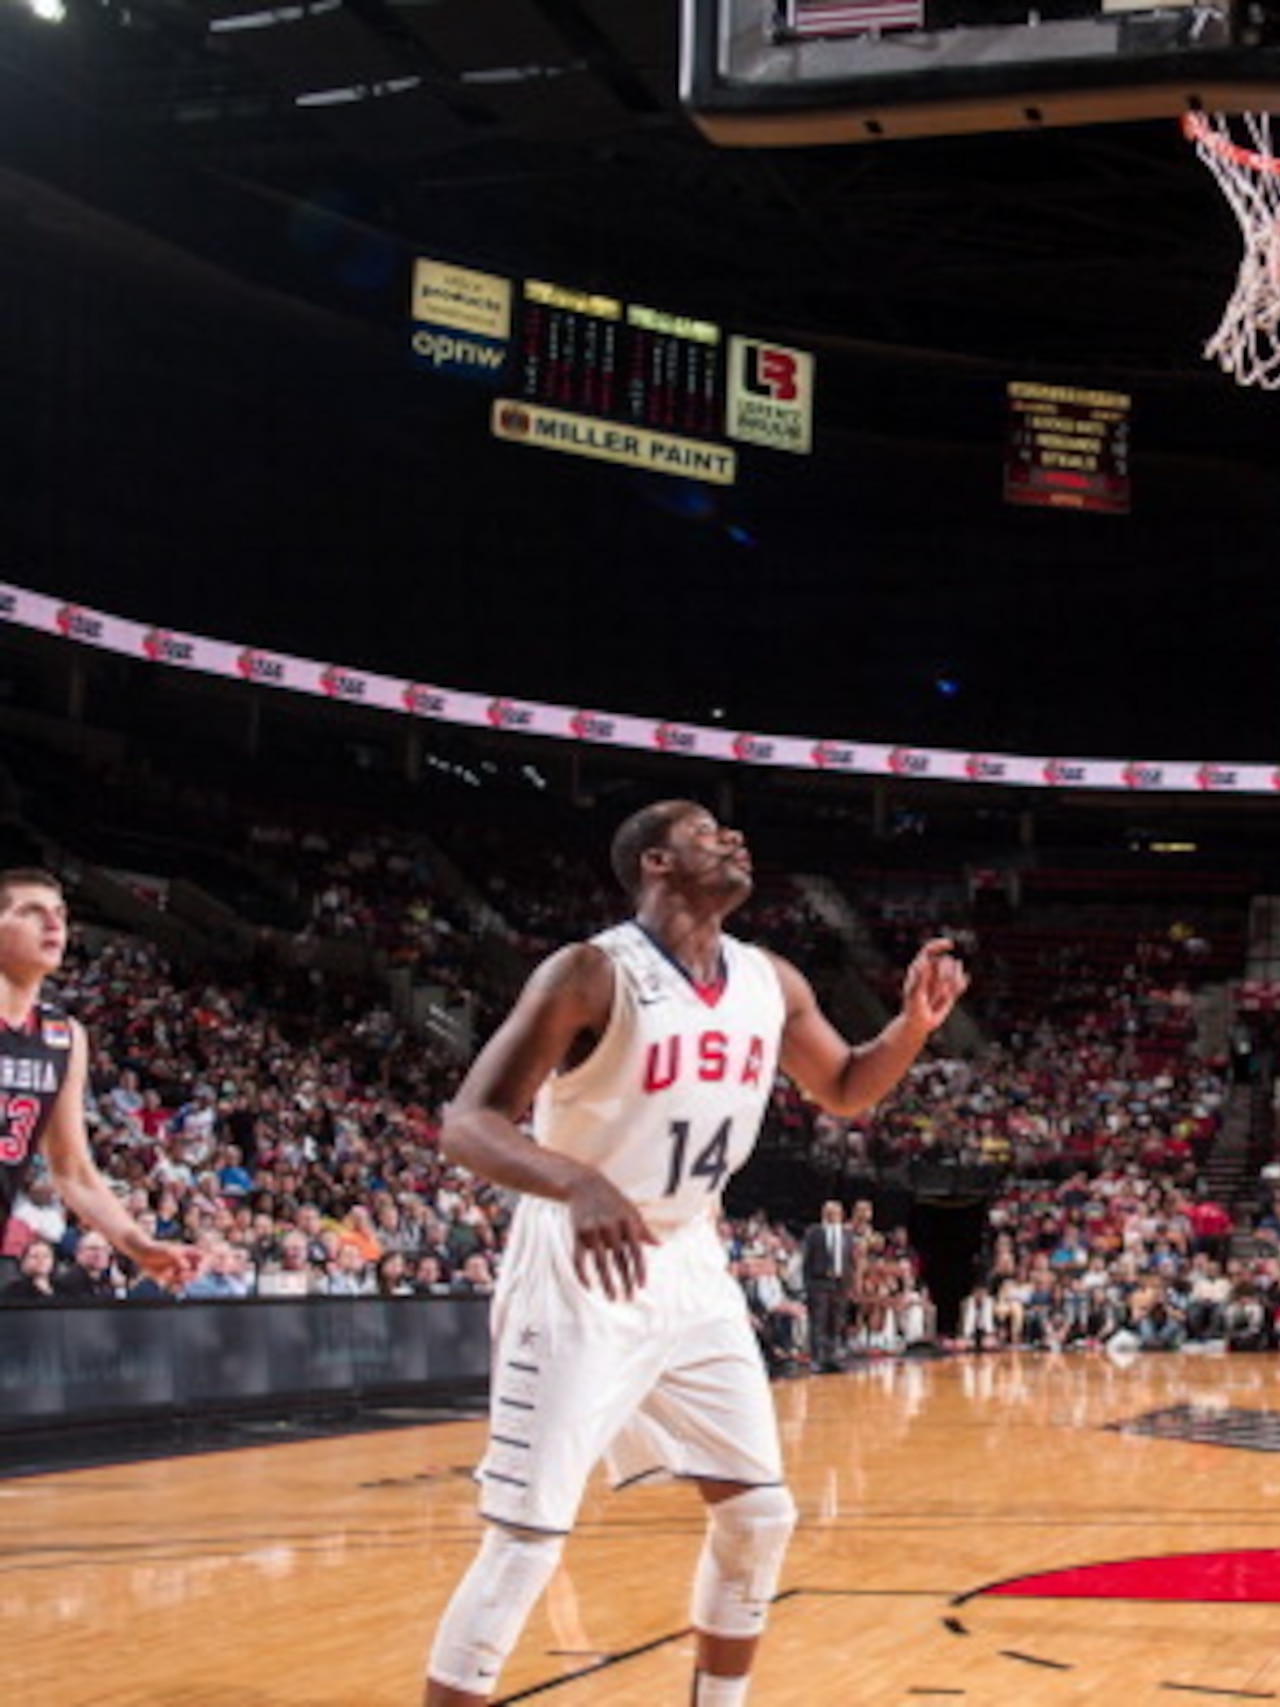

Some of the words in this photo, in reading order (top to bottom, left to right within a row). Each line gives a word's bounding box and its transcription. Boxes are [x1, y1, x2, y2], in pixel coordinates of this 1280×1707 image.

[411, 330, 507, 369] opnw
[534, 416, 640, 456] MILLER
[650, 440, 729, 475] PAINT
[642, 1030, 764, 1095] USA
[661, 1115, 734, 1198] 14
